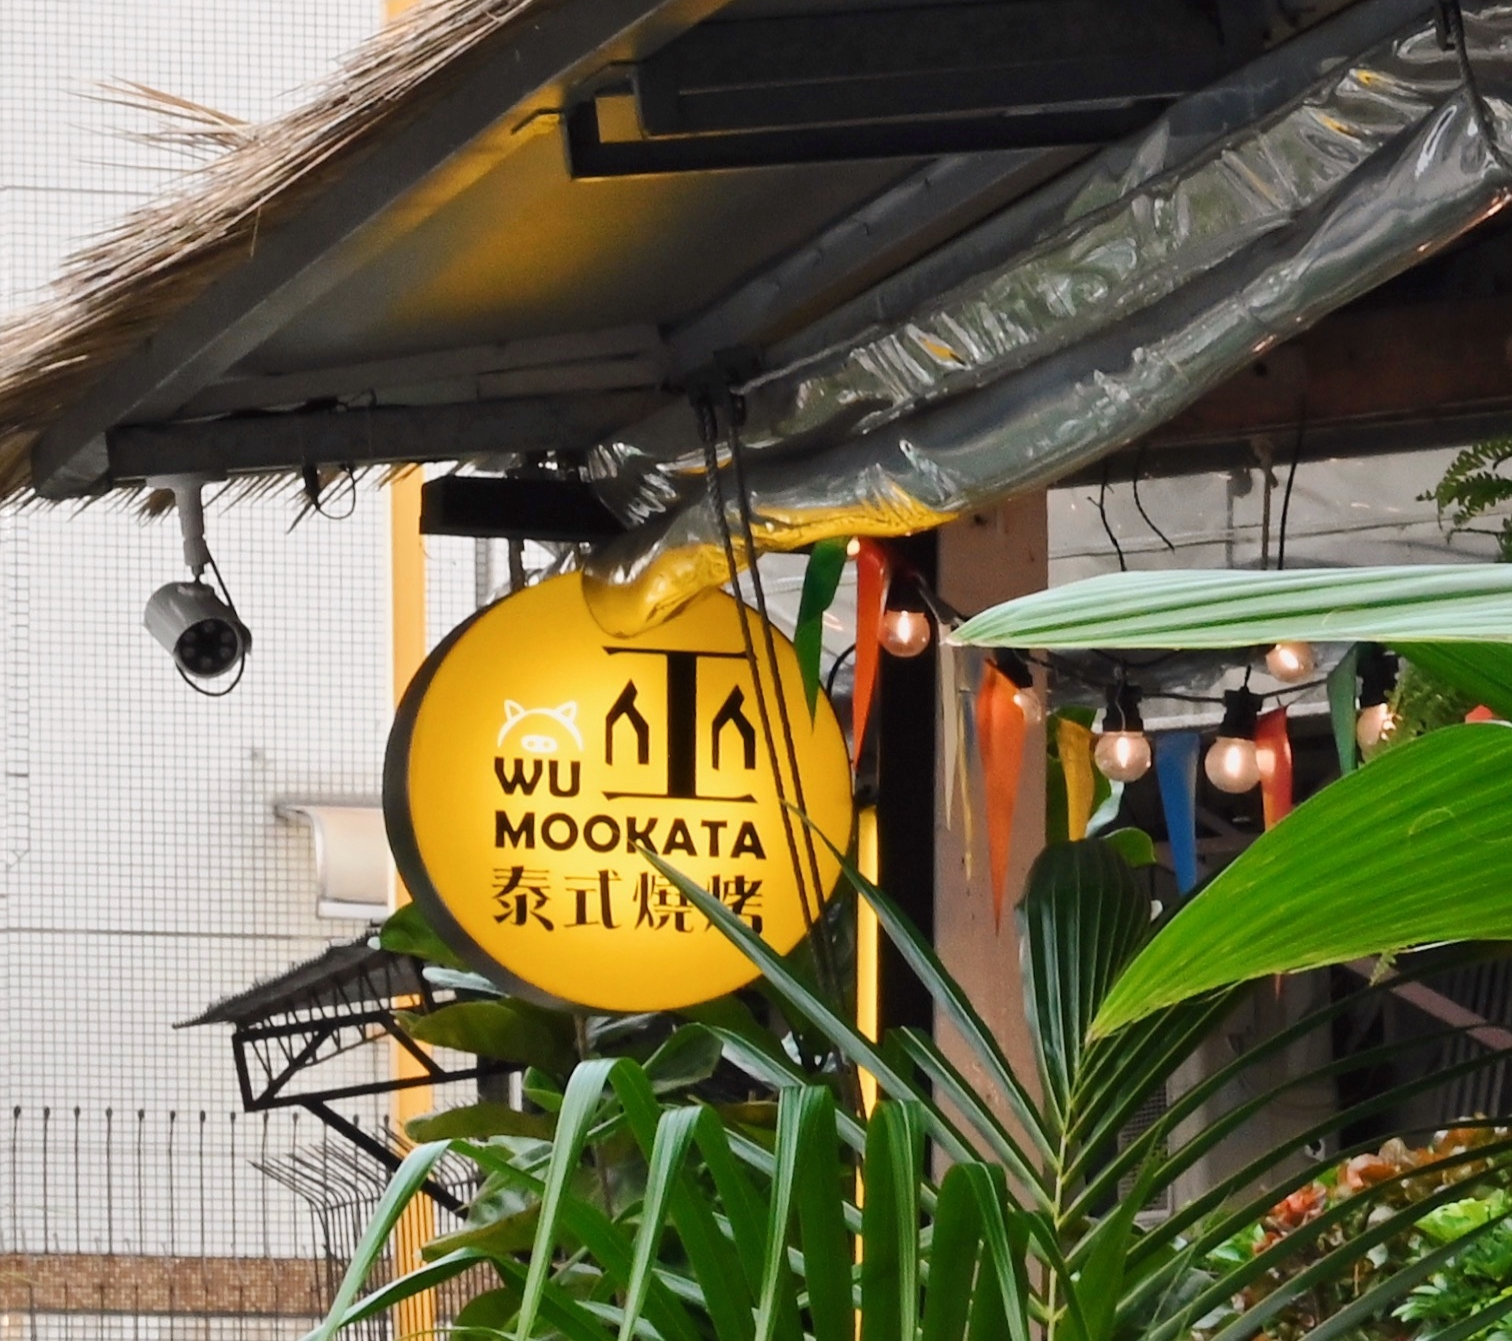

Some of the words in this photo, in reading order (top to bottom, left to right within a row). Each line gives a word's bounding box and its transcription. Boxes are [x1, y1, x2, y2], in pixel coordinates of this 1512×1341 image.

[602, 646, 758, 804] 巫
[494, 757, 582, 798] WU
[494, 810, 768, 860] MOOKATA
[492, 865, 766, 935] 泰式燒烤
